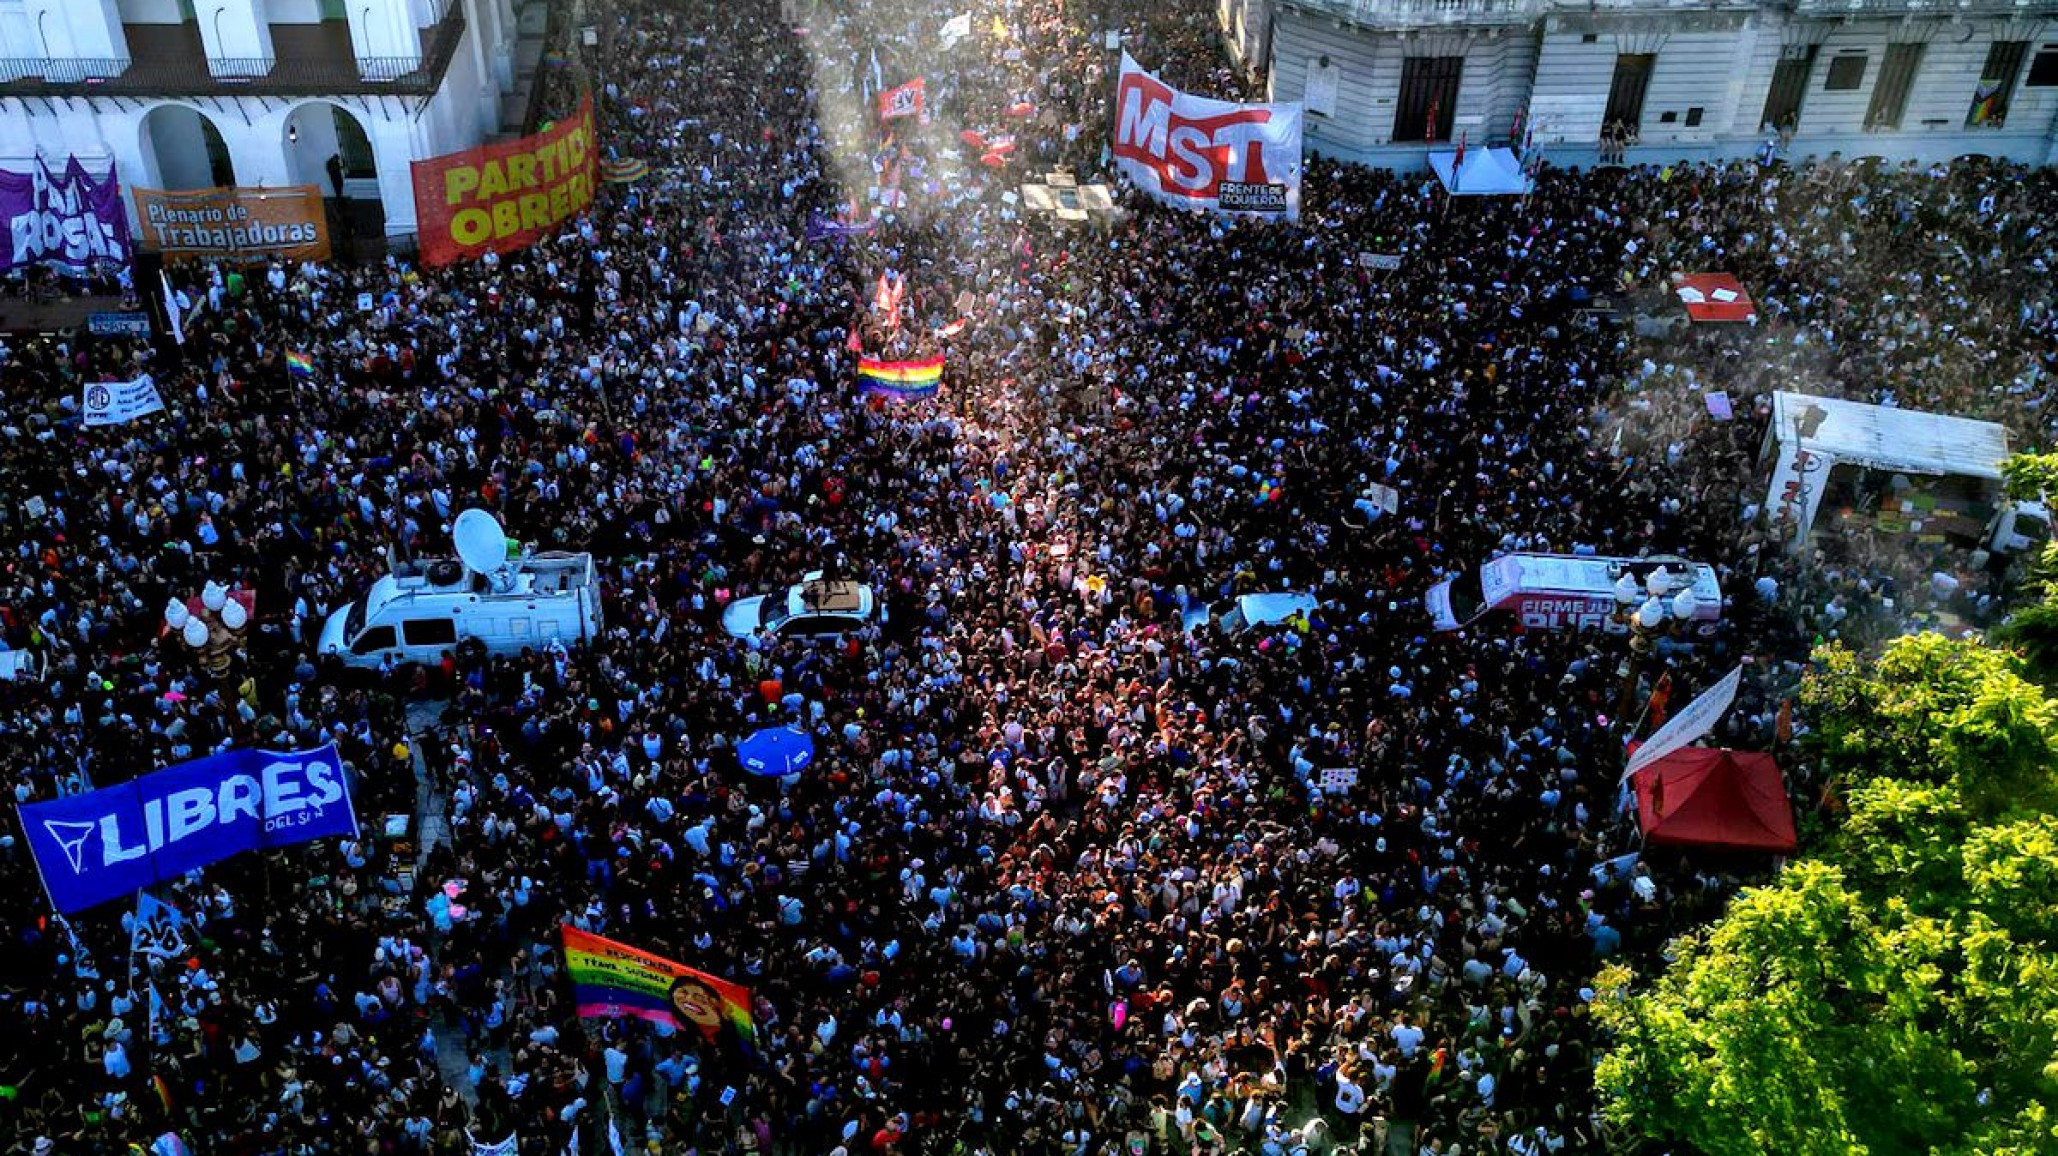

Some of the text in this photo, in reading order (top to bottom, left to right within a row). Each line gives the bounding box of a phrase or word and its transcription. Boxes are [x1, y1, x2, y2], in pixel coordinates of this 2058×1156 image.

[1119, 87, 1266, 190] MST
[1221, 182, 1269, 194] FRENTE
[149, 203, 247, 222] Plenario de
[152, 220, 317, 252] Trabajadoras
[1521, 599, 1586, 614] FIRME
[98, 761, 342, 867] LIBRES
[265, 813, 296, 832] DEL
